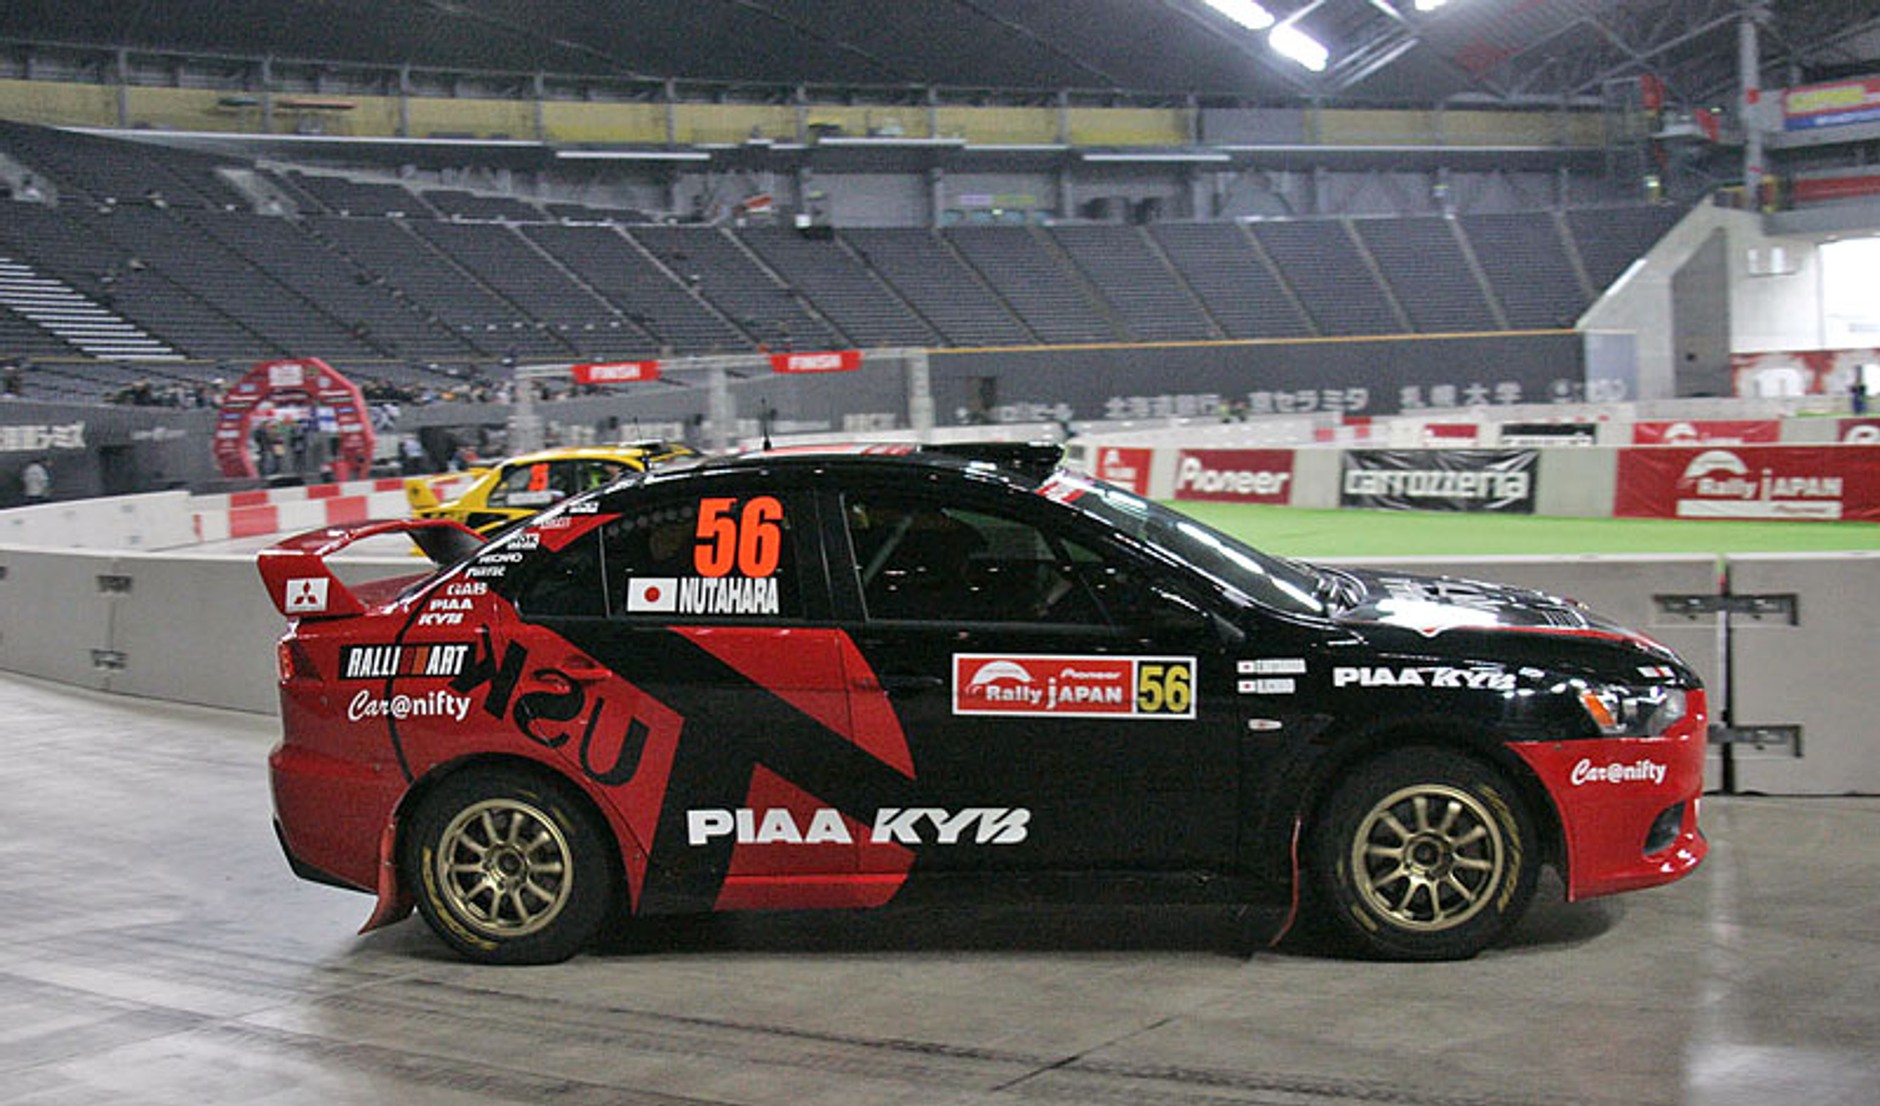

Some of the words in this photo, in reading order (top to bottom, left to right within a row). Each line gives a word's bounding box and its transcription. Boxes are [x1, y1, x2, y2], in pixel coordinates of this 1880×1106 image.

[1177, 456, 1290, 495] Pioneer
[1697, 477, 1757, 499] Rally
[694, 496, 784, 578] 56
[429, 598, 473, 611] PIAA
[679, 577, 779, 615] NUTAHARA
[986, 685, 1042, 704] Rally
[1138, 664, 1190, 712] 56
[1333, 667, 1425, 687] PIAA
[1431, 667, 1516, 690] KYB
[348, 689, 471, 721] Car@nifty
[1571, 759, 1668, 786] Car@nifty
[688, 808, 852, 845] PIAA
[871, 808, 1031, 845] KYB
